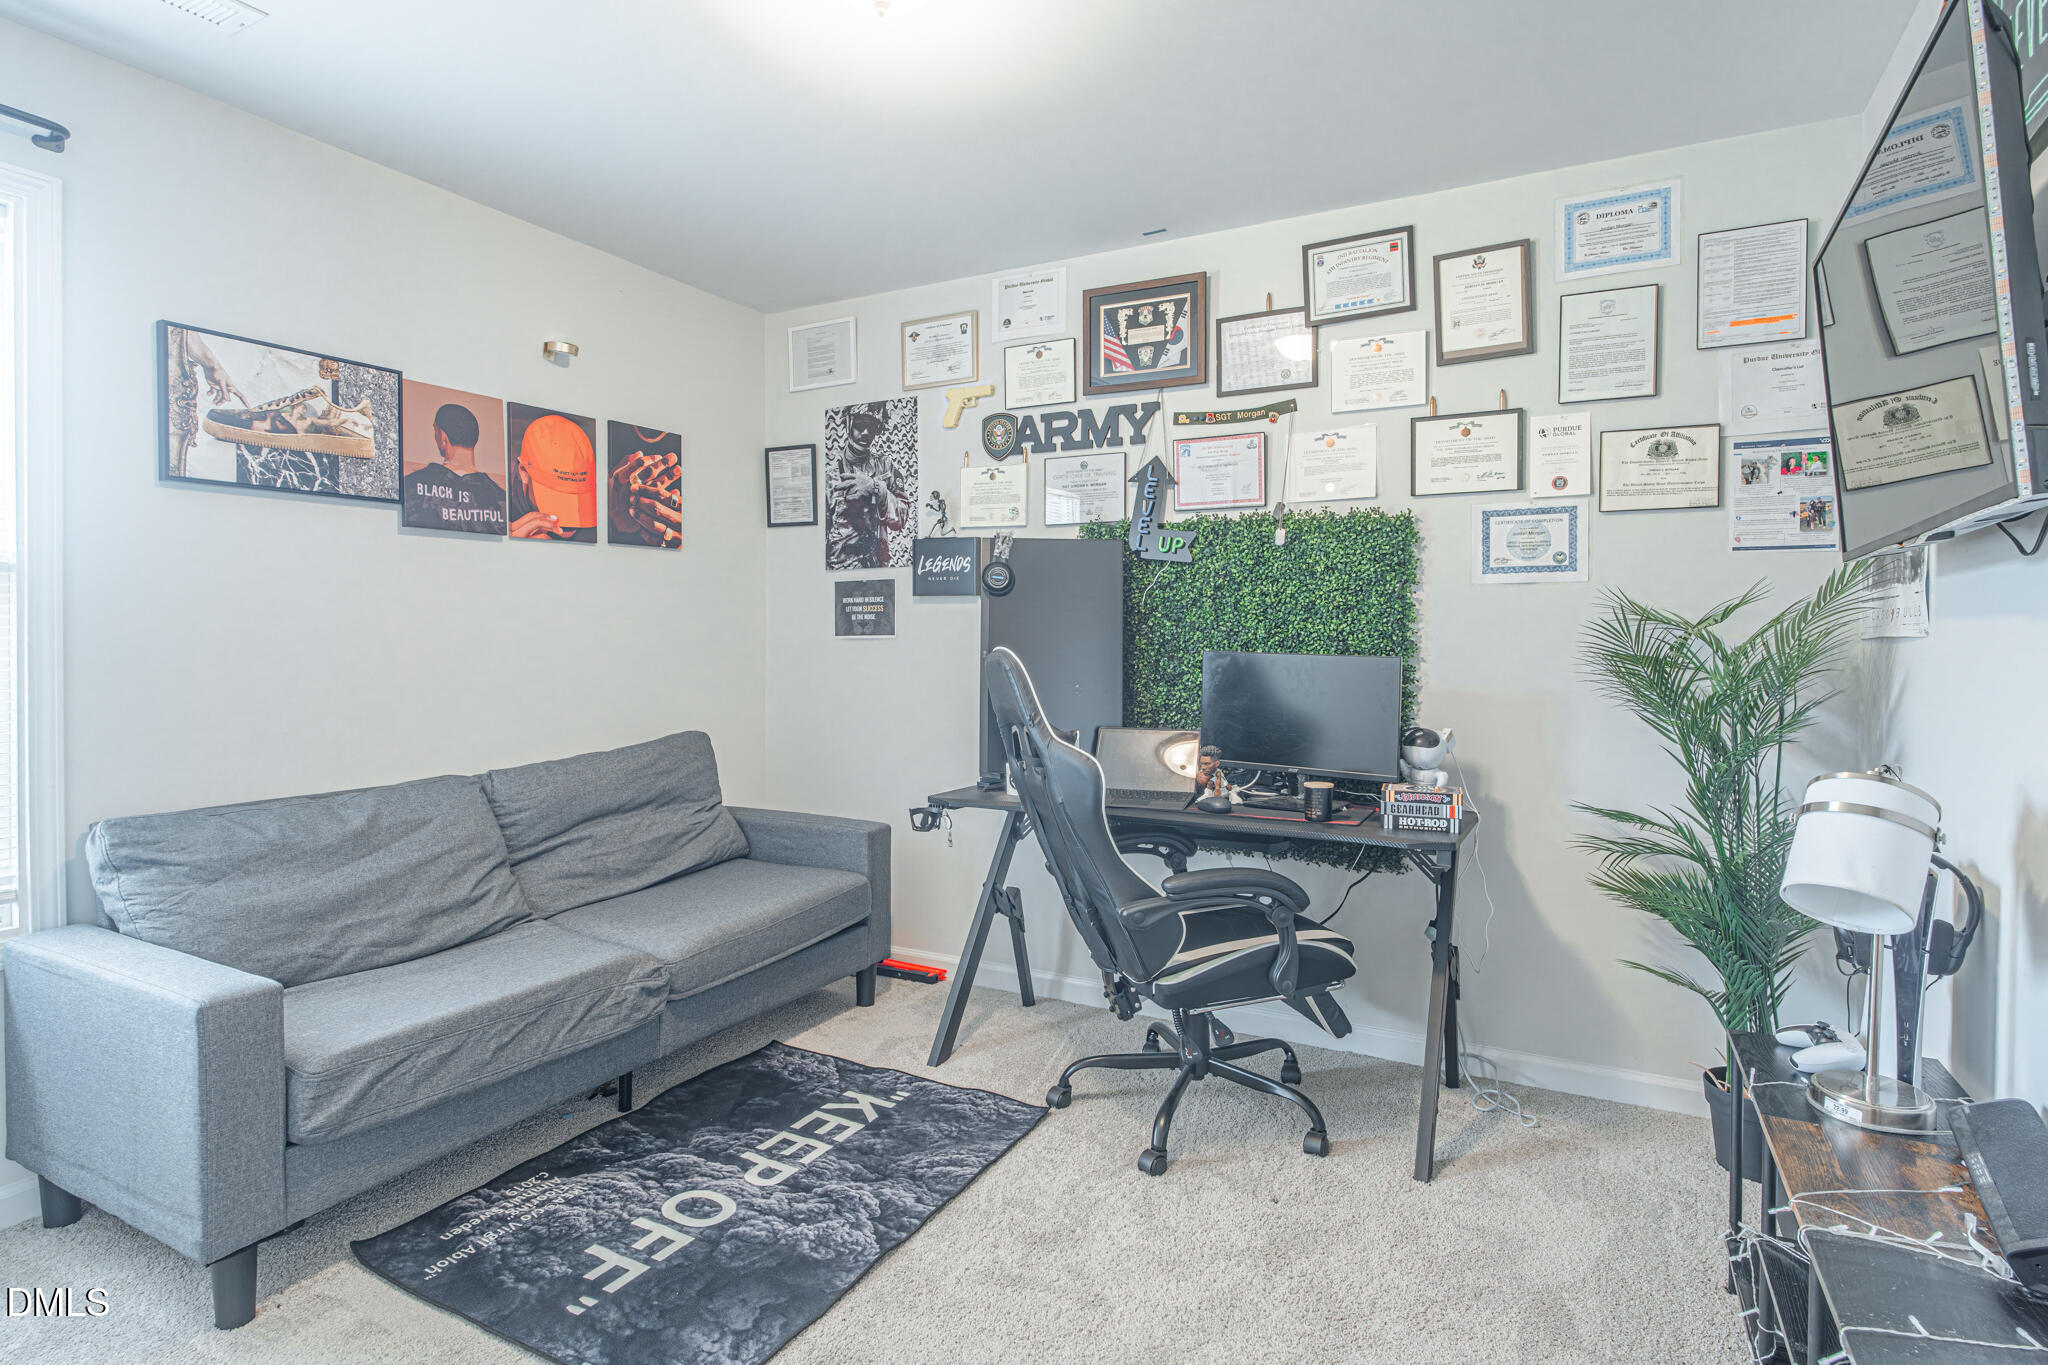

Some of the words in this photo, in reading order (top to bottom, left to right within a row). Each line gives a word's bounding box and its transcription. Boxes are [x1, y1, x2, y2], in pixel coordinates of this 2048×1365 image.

[1596, 208, 1634, 220] DIPLOMA
[1362, 255, 1389, 264] REGIMENT
[1743, 356, 1769, 364] Purdue
[1771, 351, 1809, 360] University
[1216, 412, 1232, 421] SGT
[1237, 409, 1266, 419] Morgan
[1011, 401, 1160, 455] ARMY
[1553, 424, 1582, 433] PURDUE
[1630, 433, 1658, 448] Certificate
[416, 483, 452, 499] BLACK
[458, 490, 470, 503] IS
[442, 508, 504, 522] BEAUTIFUL
[1136, 464, 1158, 553] LEVEL
[1158, 536, 1184, 553] UP
[917, 554, 972, 576] LEGENDS
[863, 604, 884, 612] SUCCESS
[1390, 803, 1440, 816] GEARHEAD
[1399, 817, 1448, 827] HOT-ROD
[477, 1221, 523, 1248] Virgil
